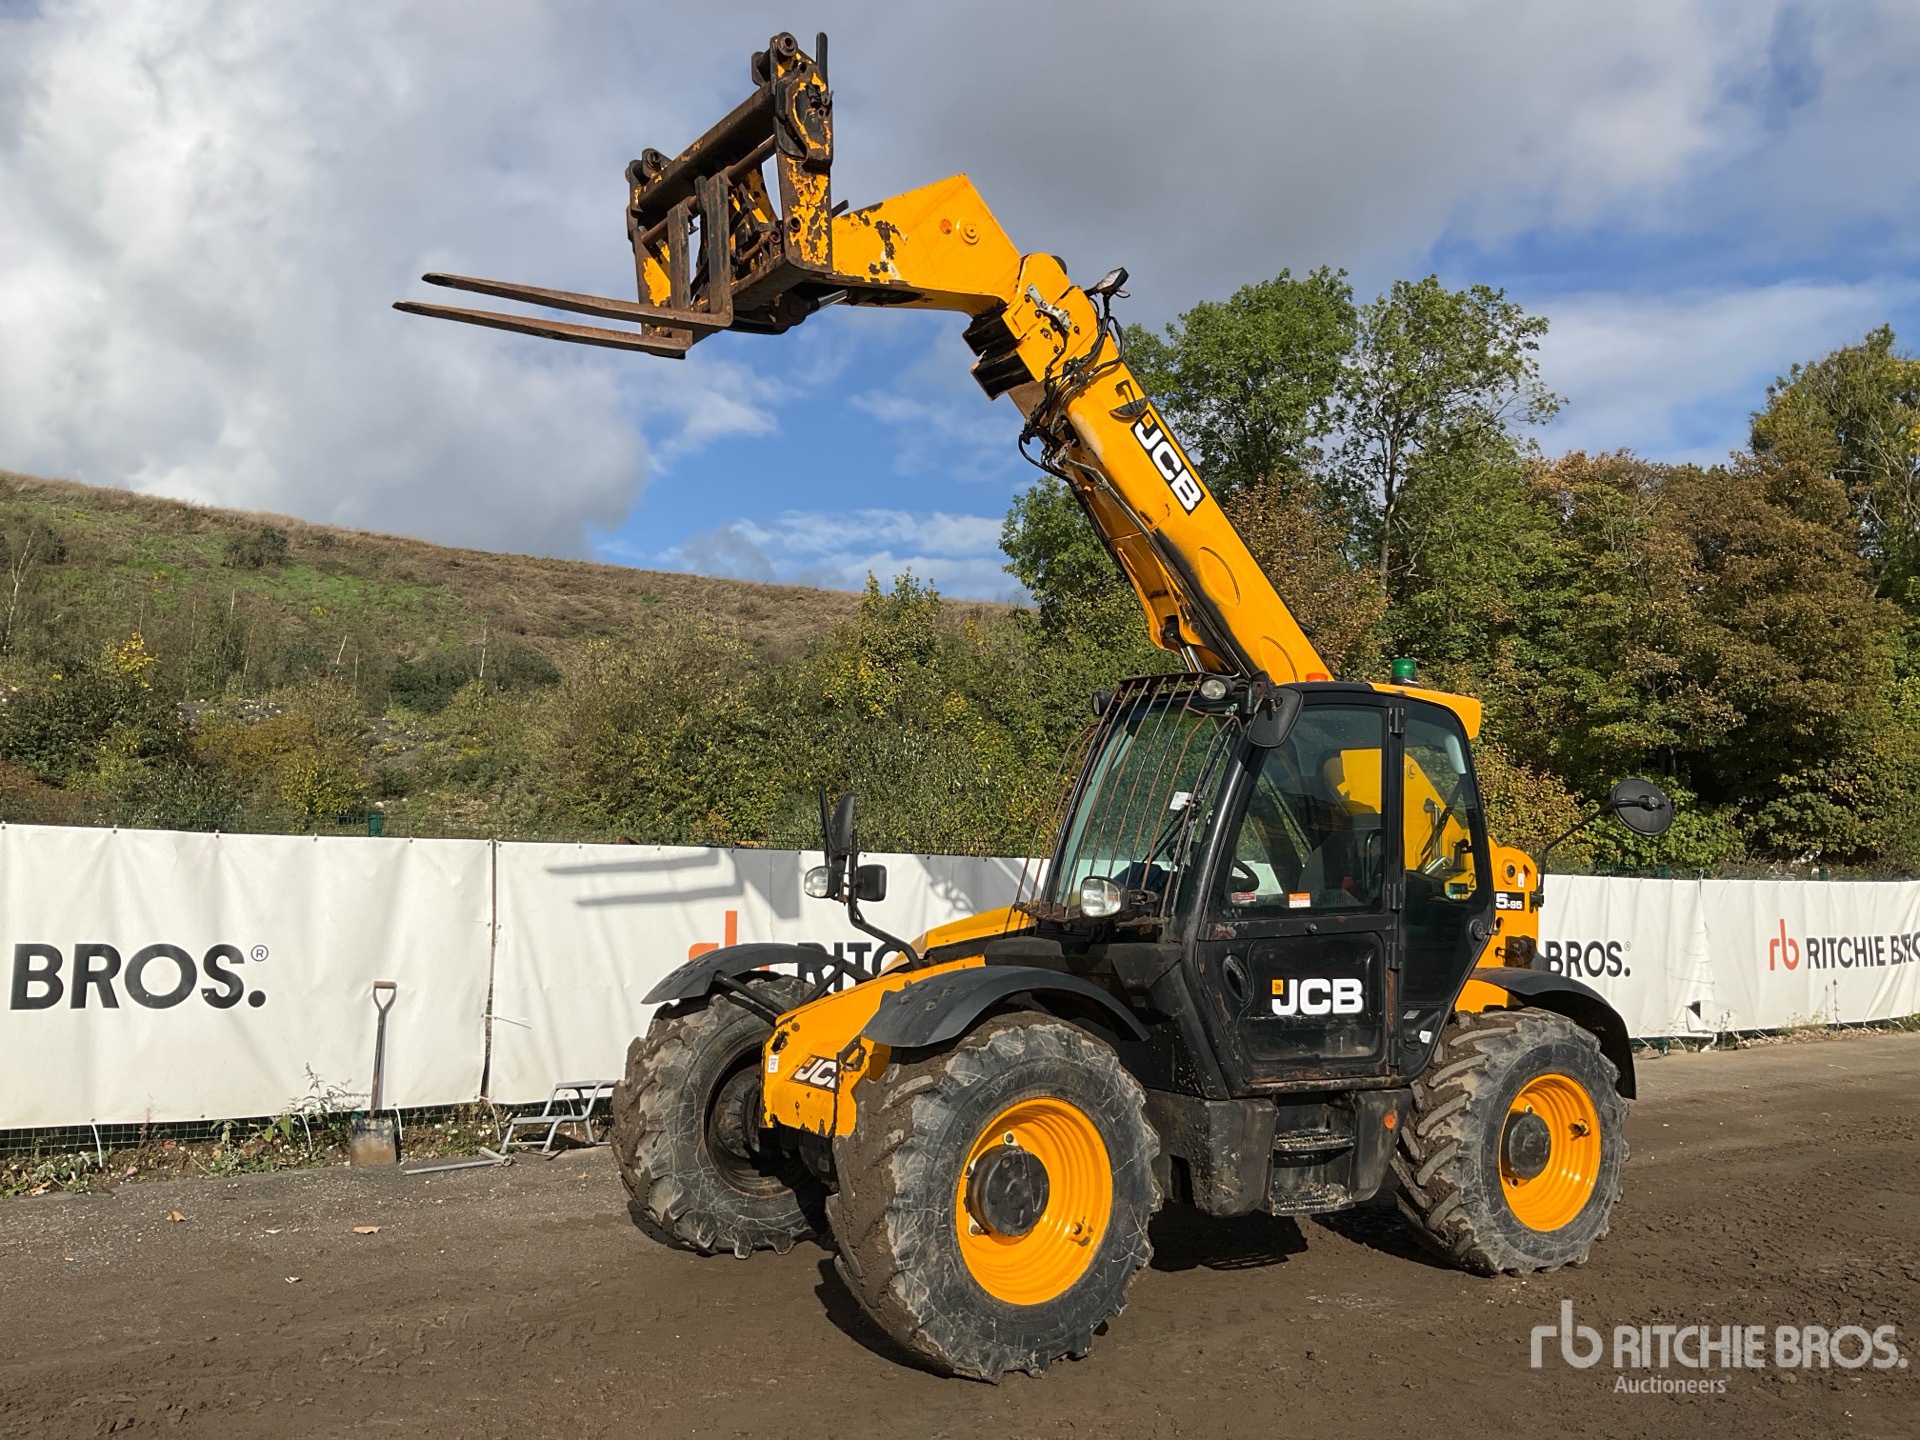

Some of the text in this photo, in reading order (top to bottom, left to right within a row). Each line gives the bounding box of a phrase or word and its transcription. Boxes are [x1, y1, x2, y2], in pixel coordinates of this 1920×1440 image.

[1134, 412, 1202, 511] JCB
[1806, 936, 1886, 969] RITCHIE
[1271, 978, 1364, 1016] JCB
